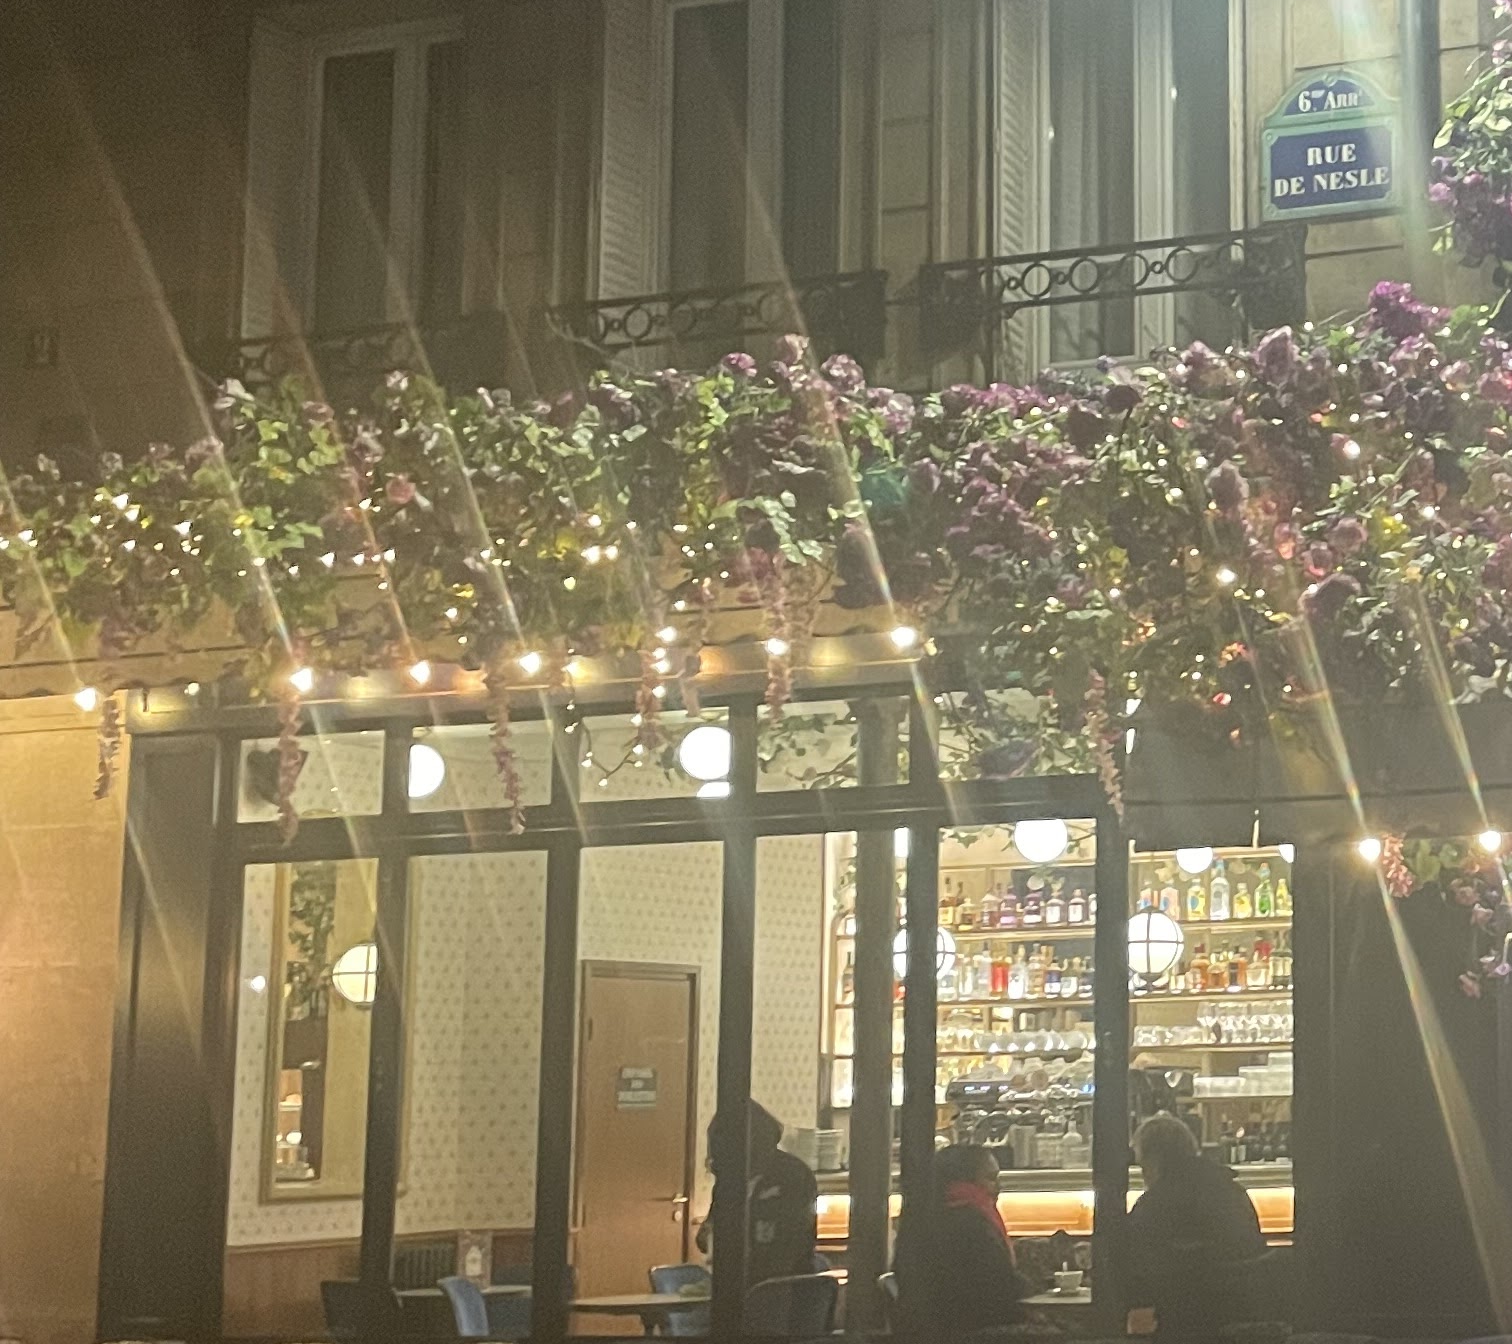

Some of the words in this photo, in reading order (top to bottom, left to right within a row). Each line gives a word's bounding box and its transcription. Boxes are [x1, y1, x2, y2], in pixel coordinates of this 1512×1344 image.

[1307, 143, 1357, 166] RUE
[1274, 176, 1305, 197] DE
[1313, 166, 1389, 192] NESLE
